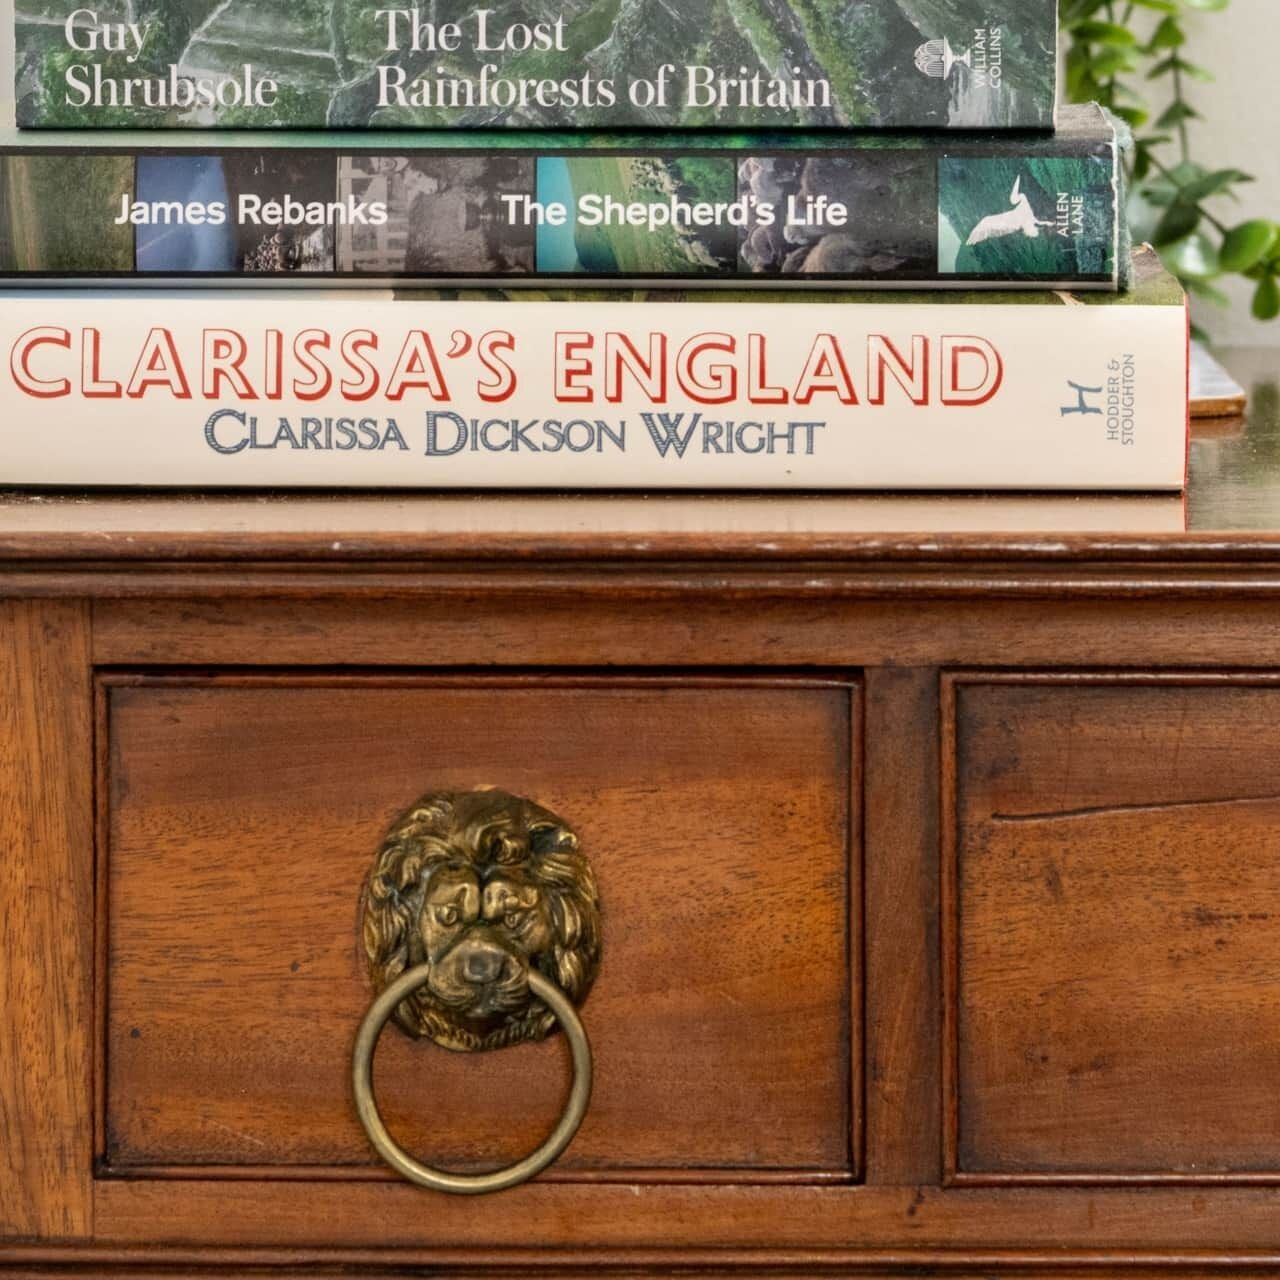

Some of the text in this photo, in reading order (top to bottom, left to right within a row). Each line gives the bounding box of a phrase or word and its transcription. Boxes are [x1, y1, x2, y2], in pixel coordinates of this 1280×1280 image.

[64, 8, 152, 62] Guy
[375, 9, 569, 52] The Lost
[973, 28, 986, 89] WILLIAM
[989, 27, 1002, 89] COLLINS
[64, 64, 280, 108] Shrubsole
[376, 63, 832, 108] Rainforests of Britain
[114, 194, 389, 226] James Rebanks
[501, 193, 848, 232] The Shepherd's Life
[1056, 192, 1069, 238] ALLEN
[1071, 195, 1084, 235] LANE
[10, 326, 1004, 407] CLARISSA'S ENGLAND
[1106, 358, 1120, 441] HODDER &
[1121, 353, 1135, 446] STOUGHTON
[204, 409, 826, 458] CLARISSA DICKSON WRIGHT
